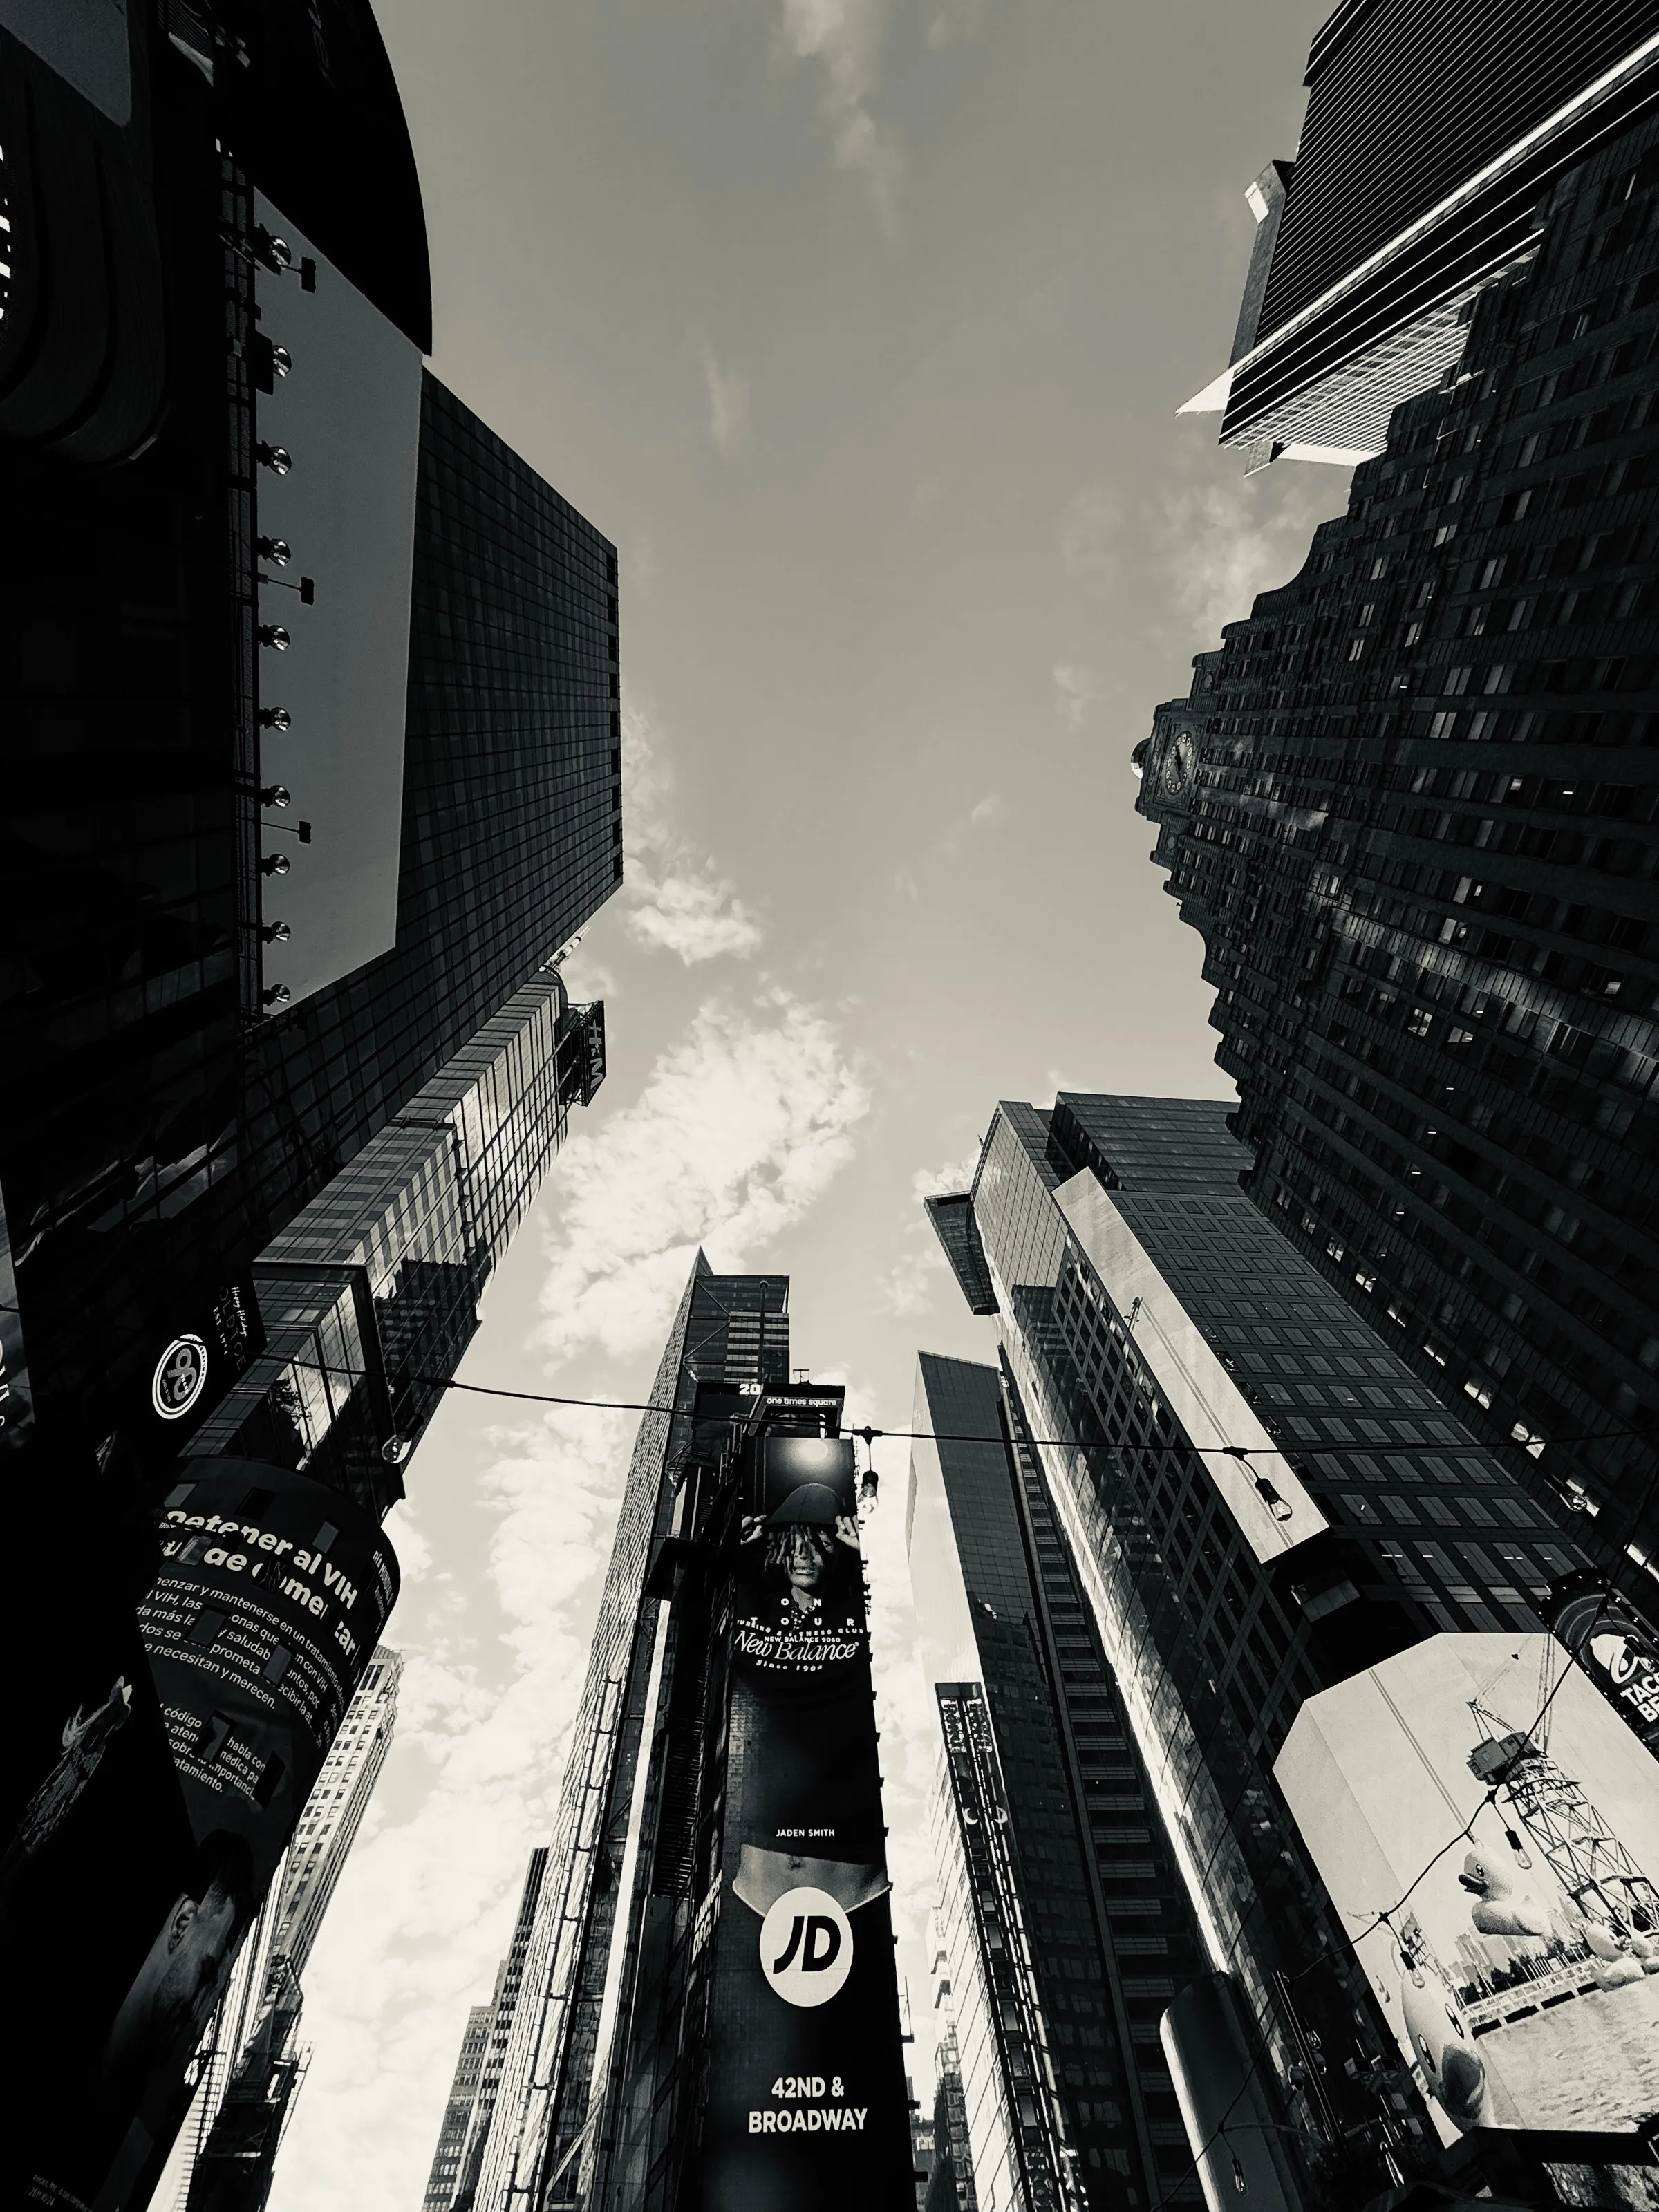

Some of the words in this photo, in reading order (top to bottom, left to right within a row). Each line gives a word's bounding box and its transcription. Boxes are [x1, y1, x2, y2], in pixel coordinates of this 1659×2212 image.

[293, 1550, 322, 1575] al
[324, 1562, 358, 1609] VIH
[152, 1609, 182, 1623] más
[217, 1629, 228, 1638] y
[226, 1630, 272, 1661] saludab
[154, 1591, 180, 1606] VIH,
[182, 1596, 203, 1610] las
[303, 1660, 317, 1678] con
[315, 1674, 328, 1693] VIH
[199, 1586, 209, 1597] y
[209, 1589, 280, 1627] mantenerse
[279, 1622, 294, 1635] en
[292, 1631, 306, 1646] un
[304, 1639, 339, 1688] tratamiento
[734, 1630, 773, 1657] New
[774, 1639, 856, 1661] Balance
[153, 1644, 220, 1674] necesitan
[219, 1667, 230, 1679] y
[229, 1671, 275, 1709] merecen.
[163, 1629, 182, 1640] se
[277, 1684, 302, 1707] ecibir
[300, 1700, 308, 1717] la
[163, 1707, 203, 1729] código
[227, 1736, 252, 1761] habla
[174, 1756, 223, 1794] atamiento.
[775, 1828, 805, 1837] JADEN
[808, 1828, 835, 1837] SMITH
[773, 1915, 841, 1974] JD
[771, 2077, 826, 2099] 42ND
[831, 2075, 845, 2097] &
[749, 2108, 868, 2133] BROADWAY
